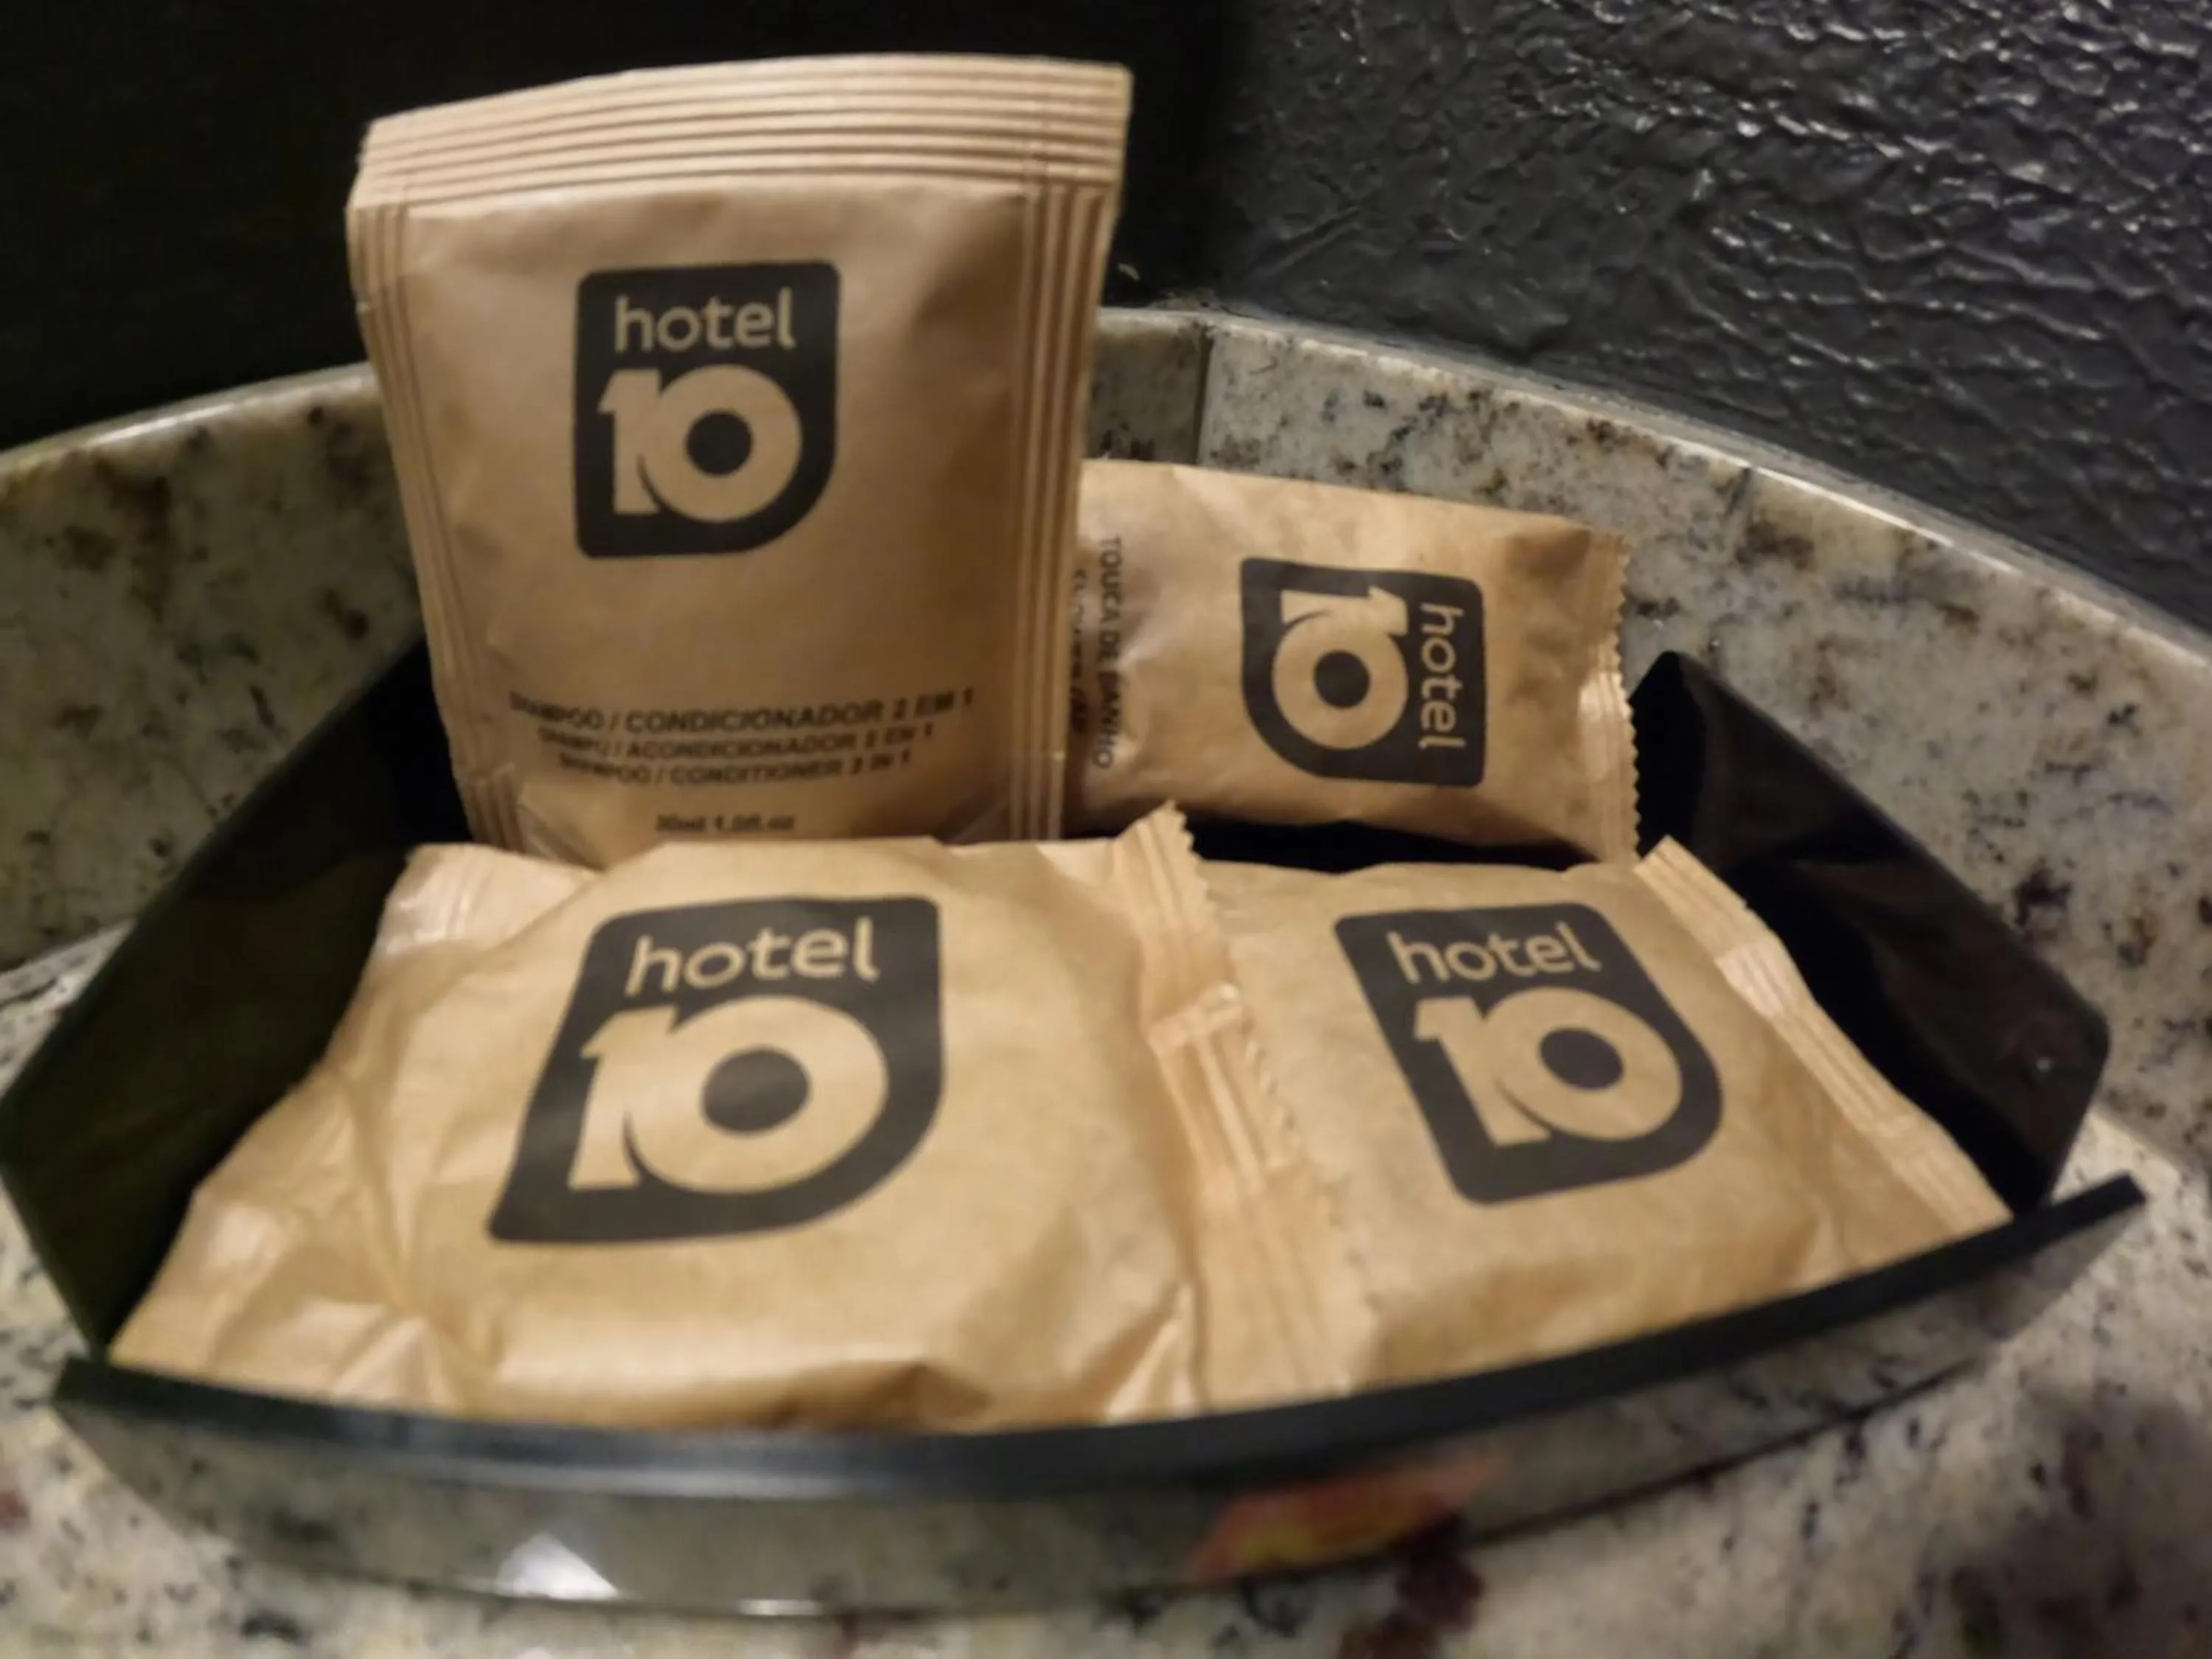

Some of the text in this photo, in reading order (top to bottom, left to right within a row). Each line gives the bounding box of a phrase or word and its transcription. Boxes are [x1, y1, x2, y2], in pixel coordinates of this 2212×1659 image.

[614, 286, 796, 354] hotel
[597, 364, 803, 524] 10
[1098, 535, 1122, 624] TOUCA
[626, 698, 883, 732] CONDICIONADOR
[1271, 585, 1409, 751] 10
[1418, 602, 1467, 750] hotel
[625, 917, 880, 997] hotel
[1386, 921, 1601, 984] hotel
[566, 995, 891, 1194] 10
[1413, 985, 1684, 1148] 10
